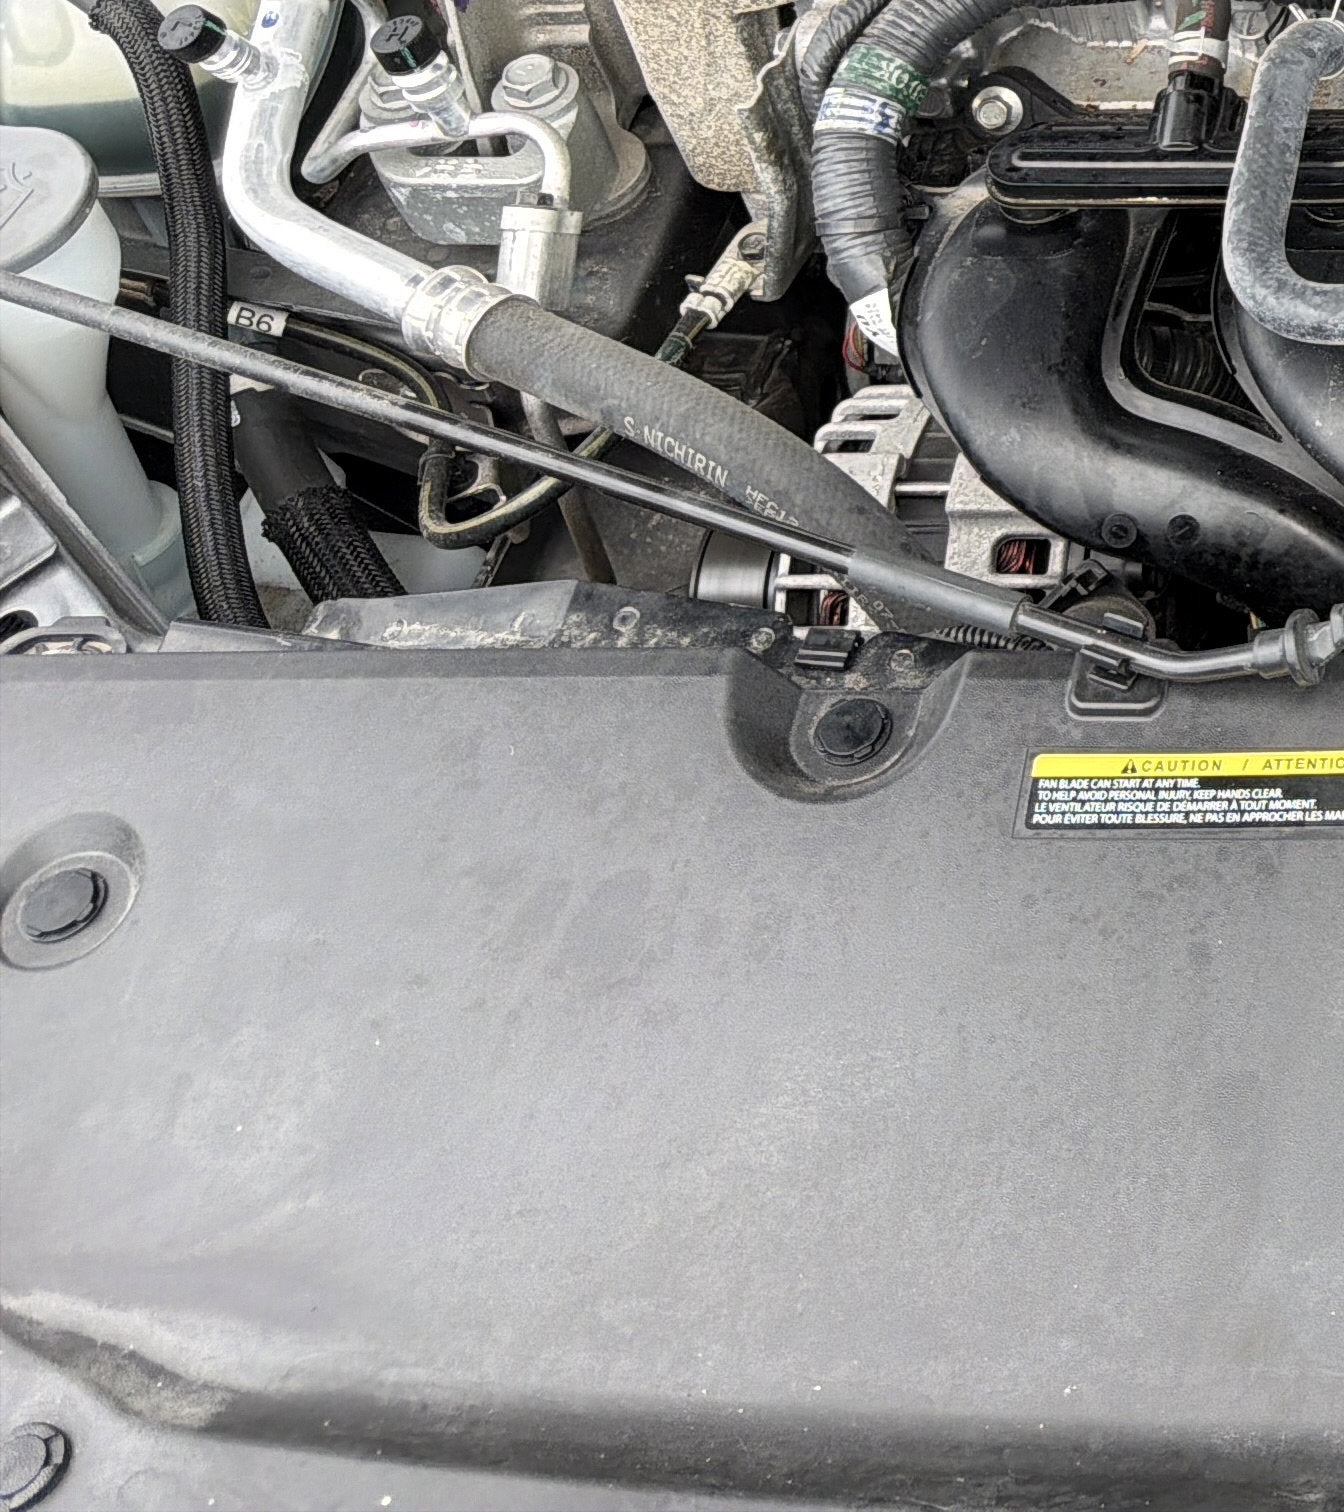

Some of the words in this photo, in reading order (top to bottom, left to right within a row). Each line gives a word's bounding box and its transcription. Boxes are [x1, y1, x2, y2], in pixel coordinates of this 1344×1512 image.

[235, 310, 275, 334] B6
[1142, 759, 1222, 772] CAUTION
[1038, 779, 1058, 788] FAN
[1059, 779, 1089, 788] BLADE
[1091, 779, 1111, 788] CAN
[1112, 778, 1144, 788] START
[1145, 778, 1154, 788] AT
[1155, 778, 1175, 788] ANY
[1038, 791, 1051, 800] TO
[1052, 791, 1075, 800] HELP
[1077, 790, 1107, 800] AVOID
[1108, 790, 1156, 800] PERSONAL
[1193, 789, 1216, 799] KEEP
[1217, 789, 1250, 799] HANDS
[1035, 802, 1047, 812] LE
[1049, 802, 1116, 812] VENTILATEUR
[1117, 801, 1154, 812] RISQUE
[1155, 801, 1169, 811] DE
[1239, 800, 1268, 810] TOUT
[1032, 814, 1063, 824] POUR
[1099, 813, 1134, 824] TOUTE
[1189, 813, 1204, 823] NE
[1205, 812, 1225, 822] PAS
[1226, 812, 1240, 822] EN
[1242, 811, 1303, 822] APPROCHER
[1305, 810, 1323, 821] LES
